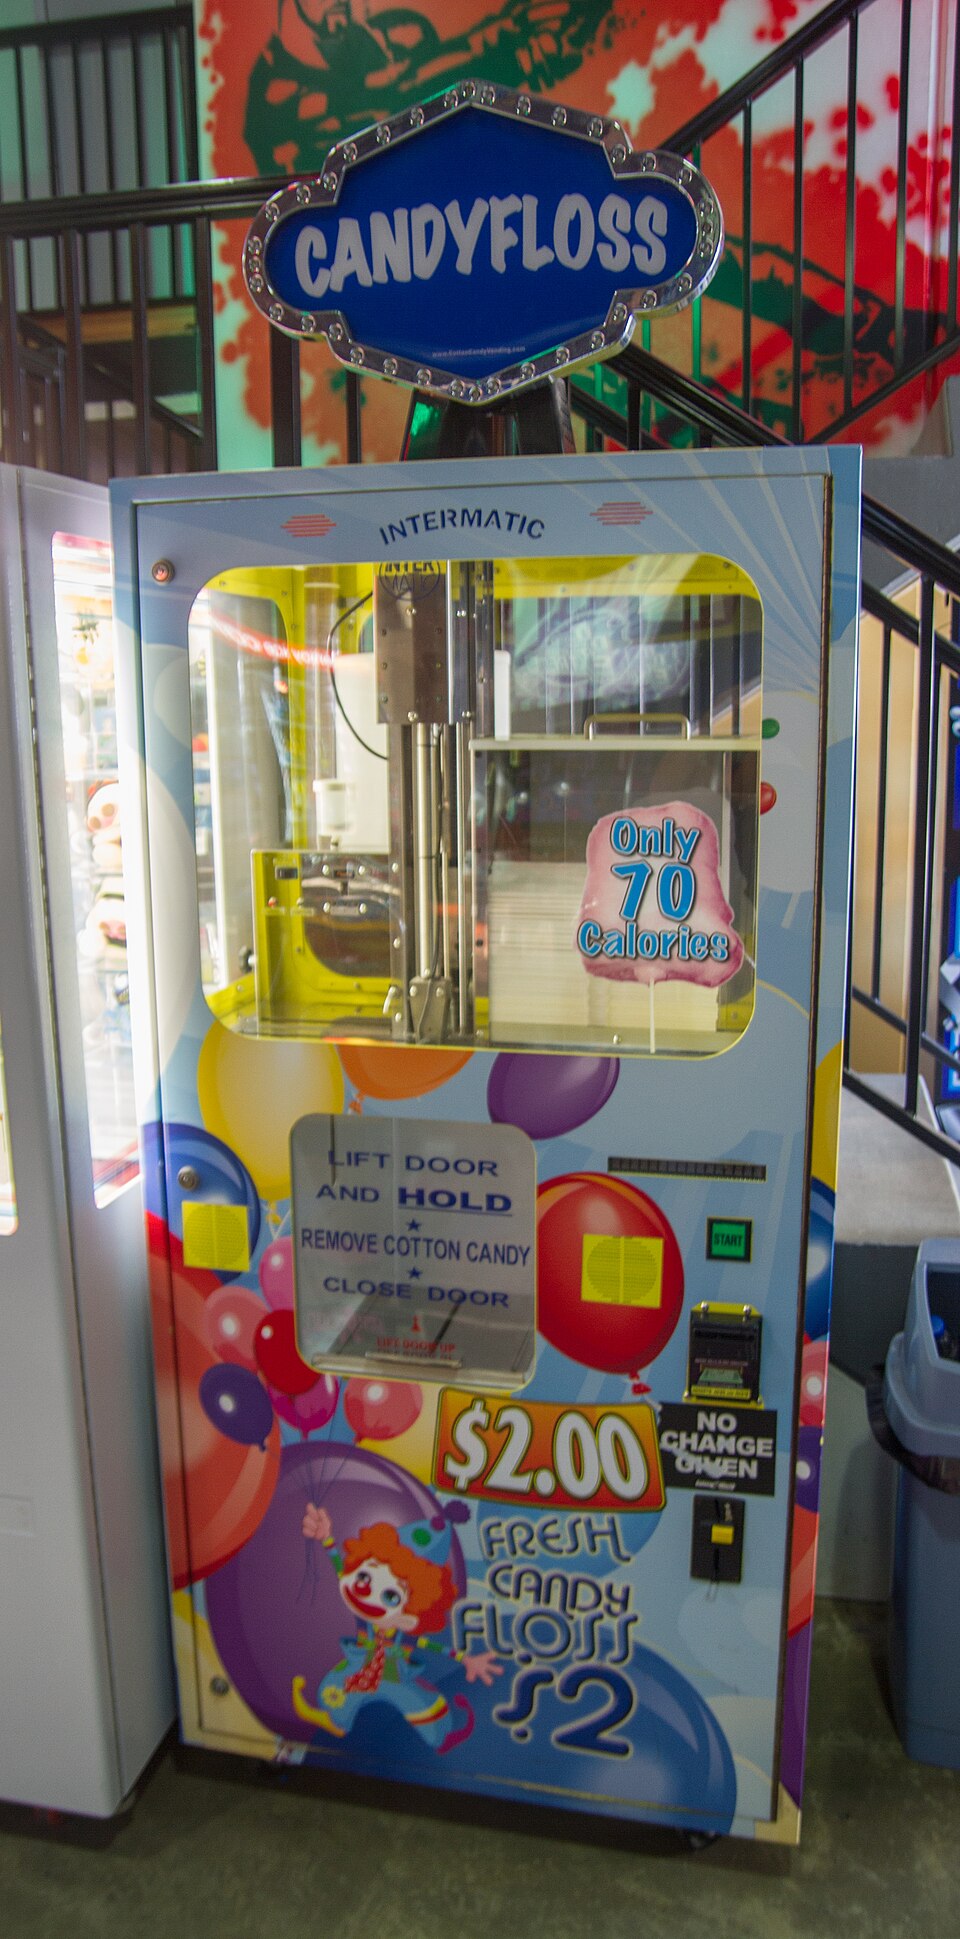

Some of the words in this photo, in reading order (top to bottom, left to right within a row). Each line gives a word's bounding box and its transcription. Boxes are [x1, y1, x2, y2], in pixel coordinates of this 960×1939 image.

[294, 193, 669, 298] CANDYFLOSS
[379, 508, 546, 546] INTERMATIC
[610, 816, 700, 864] Only
[611, 860, 696, 921] 70
[577, 920, 730, 962] Calories
[328, 1150, 390, 1169] LIFT
[405, 1155, 499, 1177] DOOR
[316, 1184, 380, 1204] AND
[398, 1187, 513, 1213] HOLD
[301, 1228, 378, 1255] REMOVE
[383, 1235, 461, 1261] COTTON
[466, 1242, 531, 1268] CANDY
[713, 1232, 743, 1248] START
[323, 1277, 412, 1299] CLOSE
[427, 1286, 510, 1308] DOOR
[697, 1411, 738, 1434] NO
[443, 1398, 649, 1501] $2.00
[660, 1430, 774, 1458] CHANGE
[481, 1513, 632, 1564] FRESH
[487, 1563, 632, 1618] CANDY
[451, 1602, 639, 1665] FLOSS
[494, 1650, 637, 1757] $2
